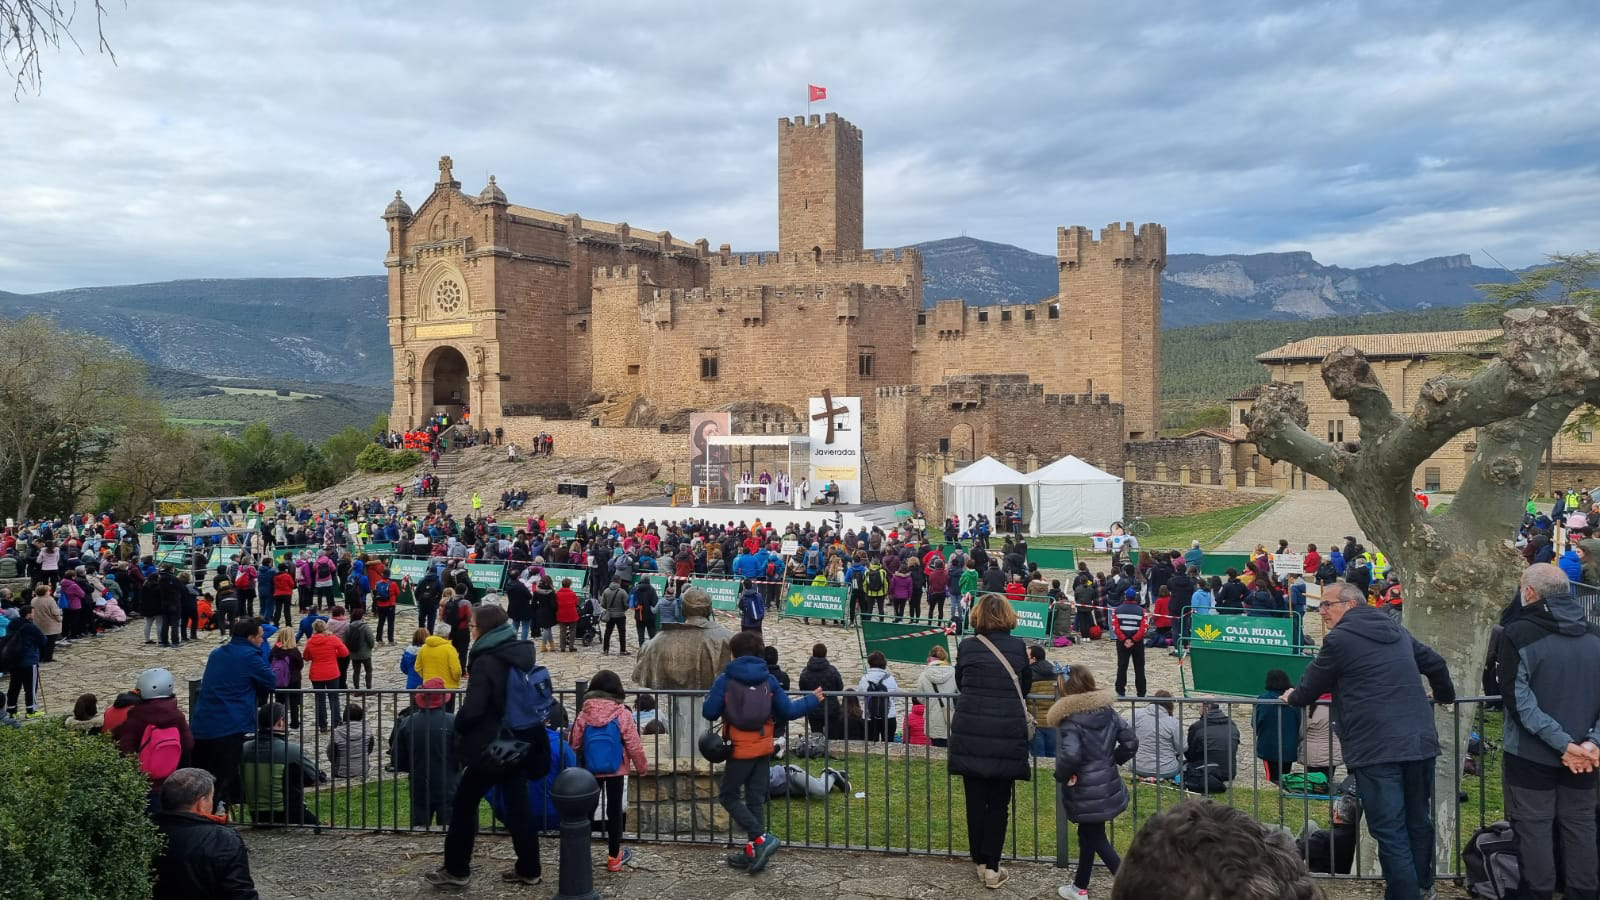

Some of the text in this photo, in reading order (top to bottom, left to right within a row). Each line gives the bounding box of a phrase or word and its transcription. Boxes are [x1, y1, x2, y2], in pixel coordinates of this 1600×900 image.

[815, 448, 856, 456] Javieradas
[806, 593, 842, 603] CAJA RURAL
[813, 602, 843, 611] NAVARRA
[1017, 610, 1042, 620] RURAL
[1016, 618, 1044, 629] VARRA
[1225, 626, 1286, 638] CAJA RURAL
